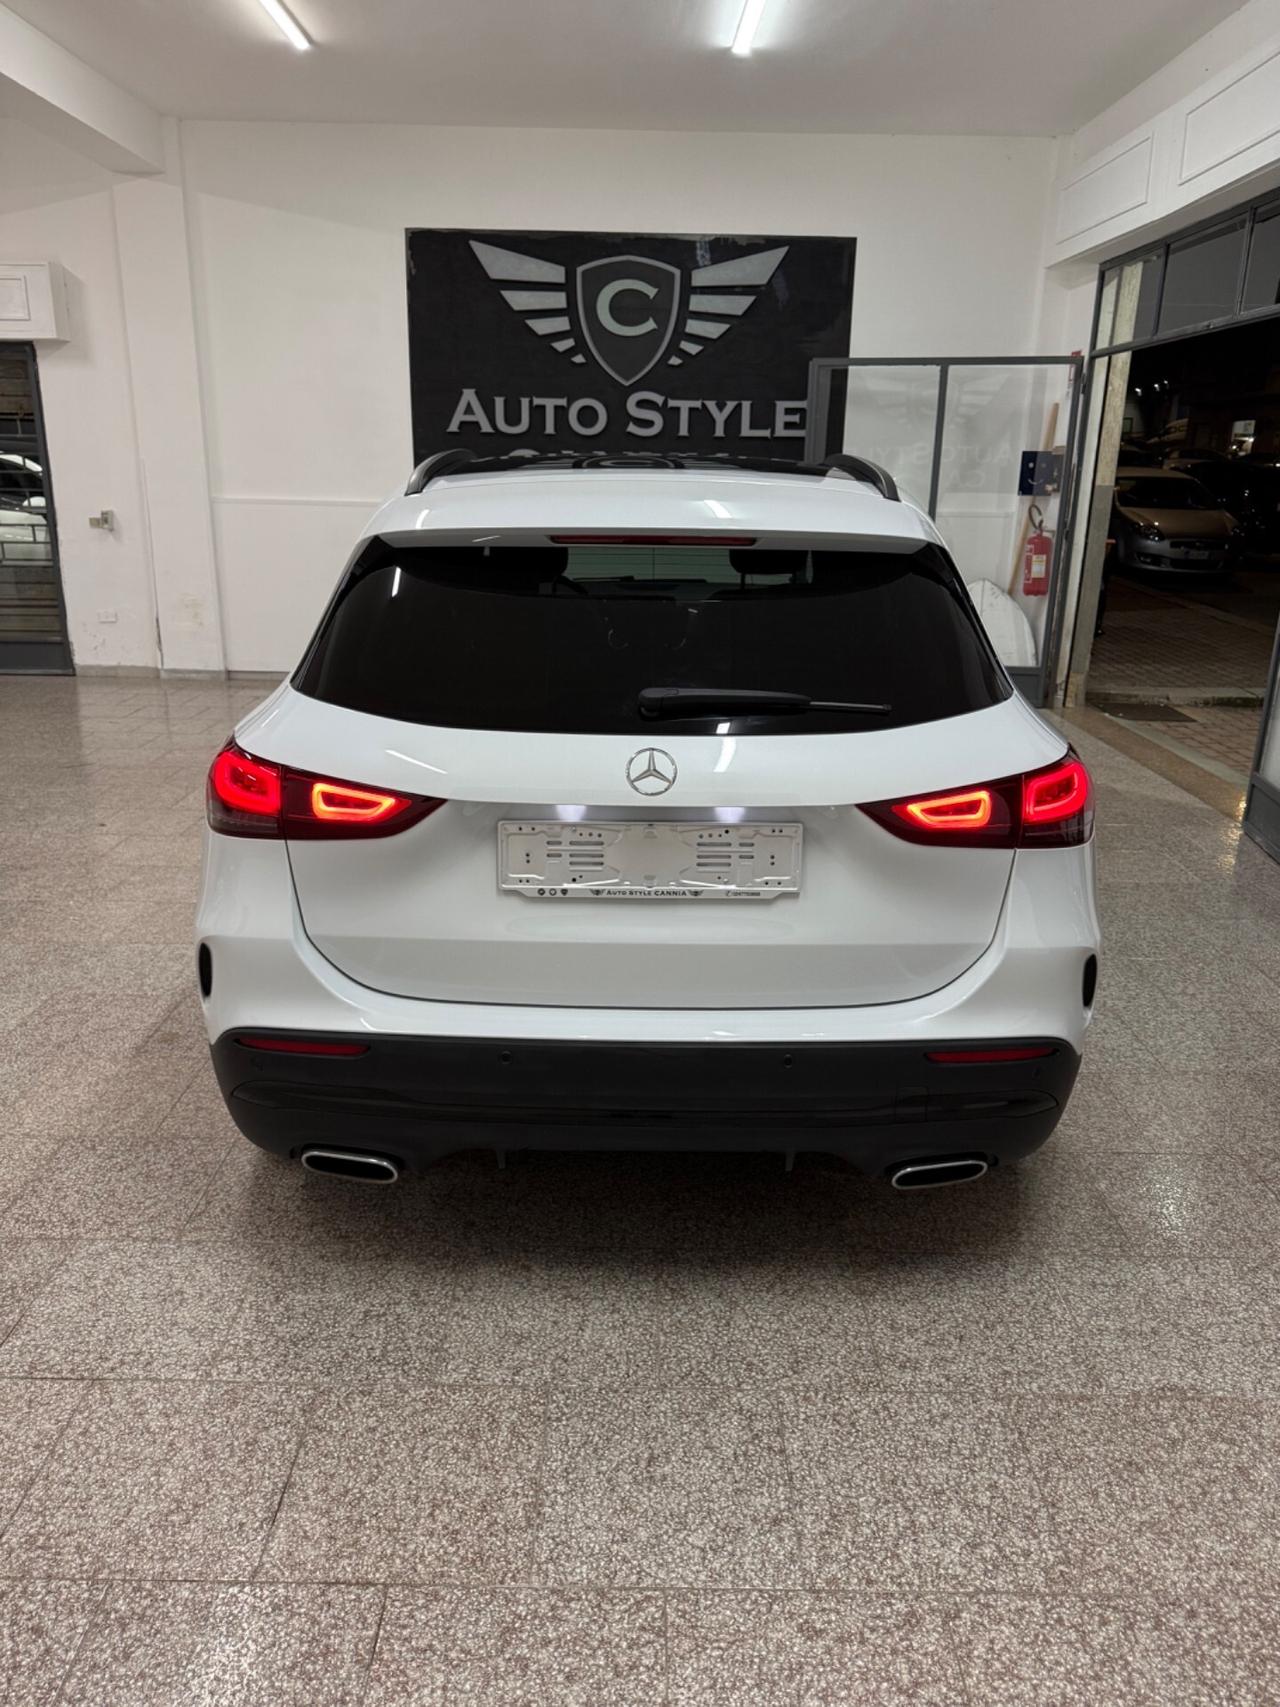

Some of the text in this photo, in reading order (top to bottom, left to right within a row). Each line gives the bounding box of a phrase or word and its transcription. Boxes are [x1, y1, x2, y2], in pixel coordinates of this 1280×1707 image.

[596, 279, 659, 337] C
[446, 388, 808, 438] AUTO STYLE
